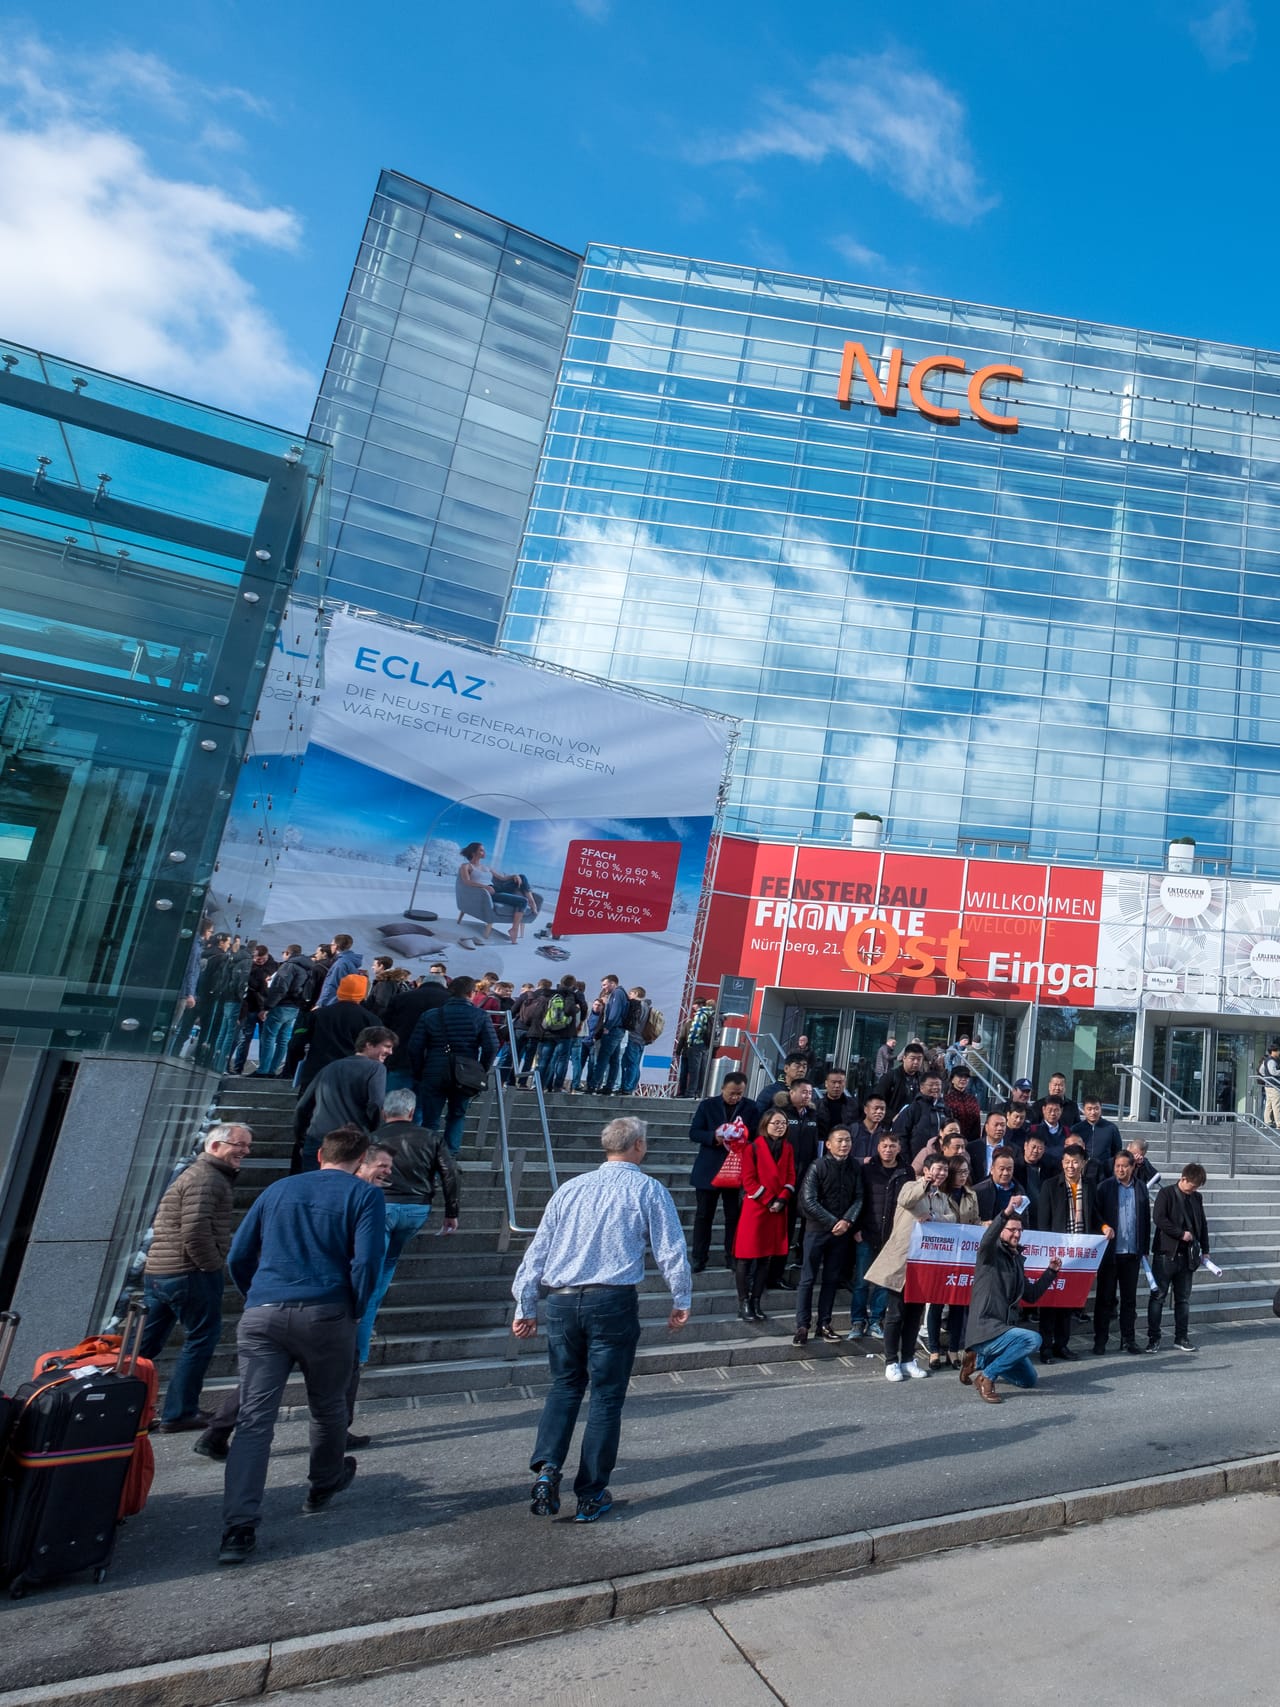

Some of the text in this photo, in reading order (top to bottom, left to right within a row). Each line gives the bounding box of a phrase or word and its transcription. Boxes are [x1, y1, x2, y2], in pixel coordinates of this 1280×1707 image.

[837, 340, 1024, 427] NCC
[345, 683, 376, 701] DIE
[382, 692, 453, 720] NEUSTE
[457, 712, 563, 747] GENERATION
[568, 738, 600, 756] VON
[341, 700, 616, 776] WÄRMESCHUTZISOLIERGLÄSERN
[581, 847, 616, 861] 2FACH
[578, 867, 592, 878] Ug
[580, 857, 592, 867] TL
[595, 861, 609, 869] 80
[625, 867, 632, 876] g
[635, 867, 648, 876] 60
[574, 886, 609, 899] 3FACH
[759, 876, 928, 908] FENSTERBAU
[569, 906, 584, 917] Ug
[573, 897, 584, 906] TL
[588, 899, 601, 908] 77
[626, 906, 639, 914] 60
[966, 890, 1096, 916] WILLKOMMEN
[964, 916, 1057, 937] WELCOME
[751, 938, 819, 955] Nürnberg,
[843, 919, 969, 980] Ost
[961, 1240, 980, 1251] 2018
